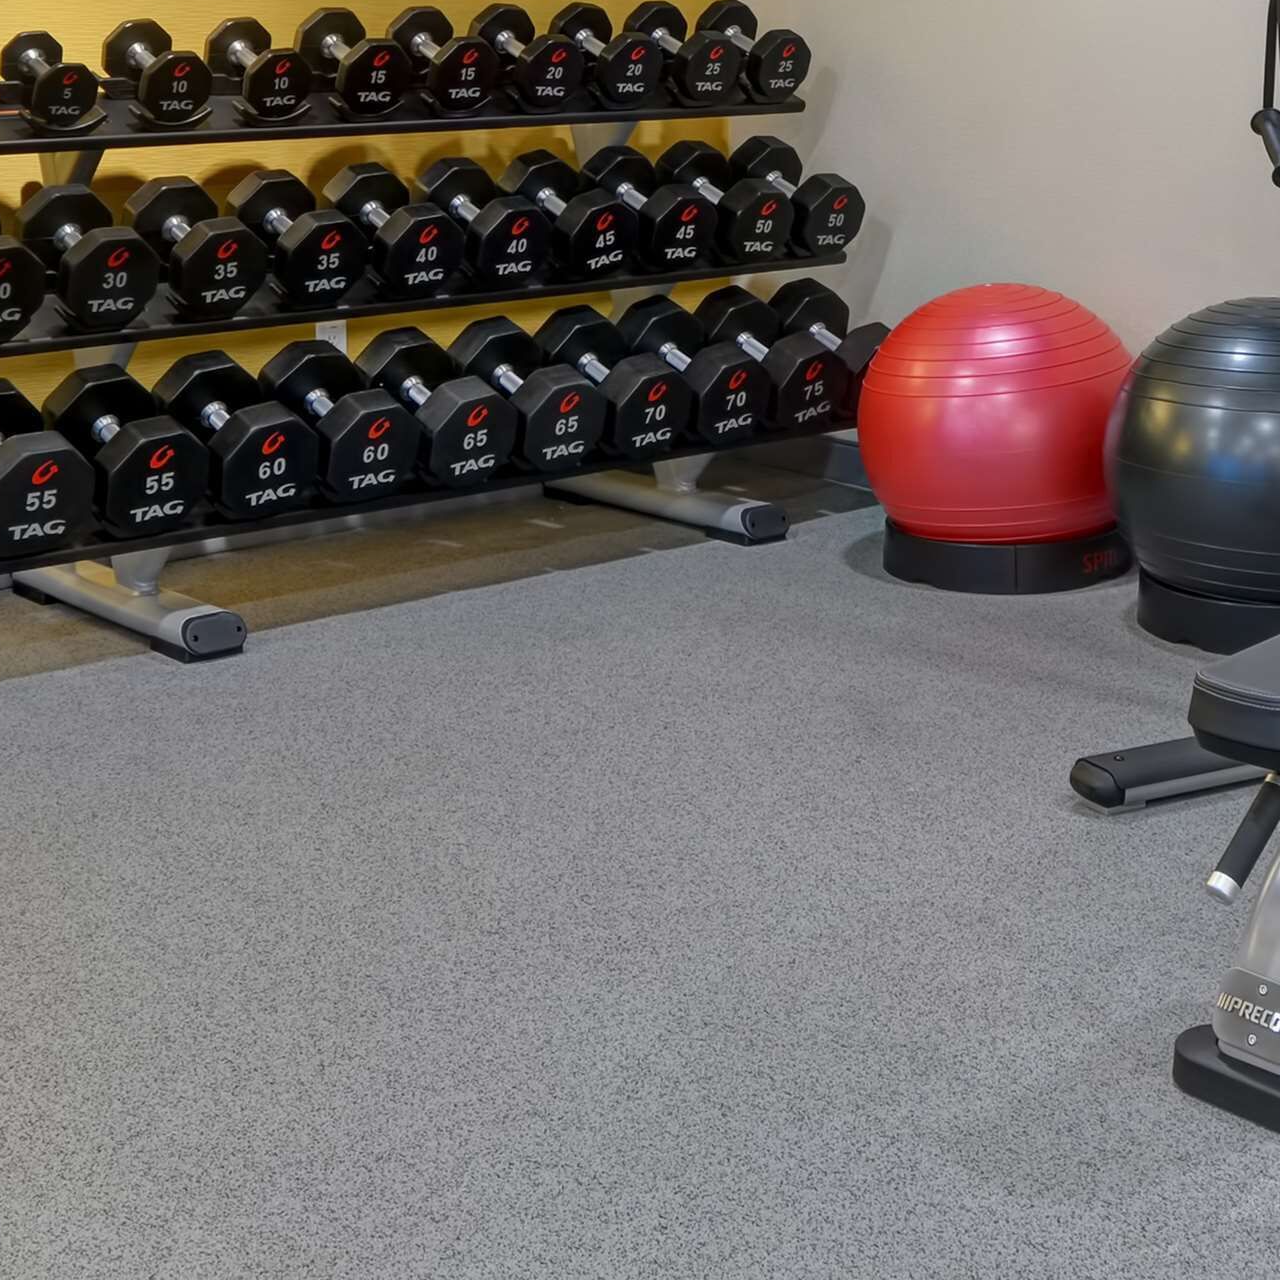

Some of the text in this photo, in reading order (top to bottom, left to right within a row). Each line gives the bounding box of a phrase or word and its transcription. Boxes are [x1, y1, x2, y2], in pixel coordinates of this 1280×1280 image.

[461, 68, 475, 80] 15
[546, 67, 563, 79] 20
[627, 64, 642, 76] 20
[705, 63, 721, 75] 25
[779, 61, 793, 72] 25
[275, 77, 288, 89] 10
[371, 70, 386, 83] 15
[769, 79, 794, 88] TAG
[64, 88, 72, 99] 5
[173, 80, 187, 93] 10
[449, 88, 480, 98] TAG
[536, 87, 564, 96] TAG
[617, 83, 644, 92] TAG
[696, 82, 722, 91] TAG
[264, 95, 295, 106] TAG
[358, 91, 390, 102] TAG
[49, 106, 80, 115] TAG
[160, 100, 193, 110] TAG
[756, 220, 772, 233] 50
[828, 214, 844, 227] 50
[596, 231, 614, 248] 45
[676, 225, 695, 239] 45
[817, 234, 845, 245] TAG
[507, 239, 527, 253] 40
[665, 247, 696, 259] TAG
[744, 241, 773, 251] TAG
[318, 253, 339, 270] 35
[416, 247, 437, 262] 40
[587, 250, 622, 269] TAG
[214, 262, 237, 279] 35
[496, 261, 531, 275] TAG
[103, 272, 127, 288] 30
[405, 269, 443, 284] TAG
[305, 277, 346, 292] TAG
[202, 286, 245, 303] TAG
[88, 297, 133, 312] TAG
[804, 381, 823, 400] 75
[727, 392, 746, 410] 70
[645, 405, 665, 424] 70
[795, 401, 830, 423] TAG
[556, 416, 578, 435] 65
[715, 413, 752, 433] TAG
[464, 429, 487, 449] 65
[632, 428, 671, 447] TAG
[363, 444, 388, 463] 60
[543, 441, 584, 460] TAG
[259, 458, 285, 479] 60
[451, 454, 494, 475] TAG
[146, 472, 174, 494] 55
[349, 470, 395, 489] TAG
[26, 490, 57, 511] 55
[246, 483, 296, 506] TAG
[130, 500, 184, 522] TAG
[8, 520, 65, 540] TAG
